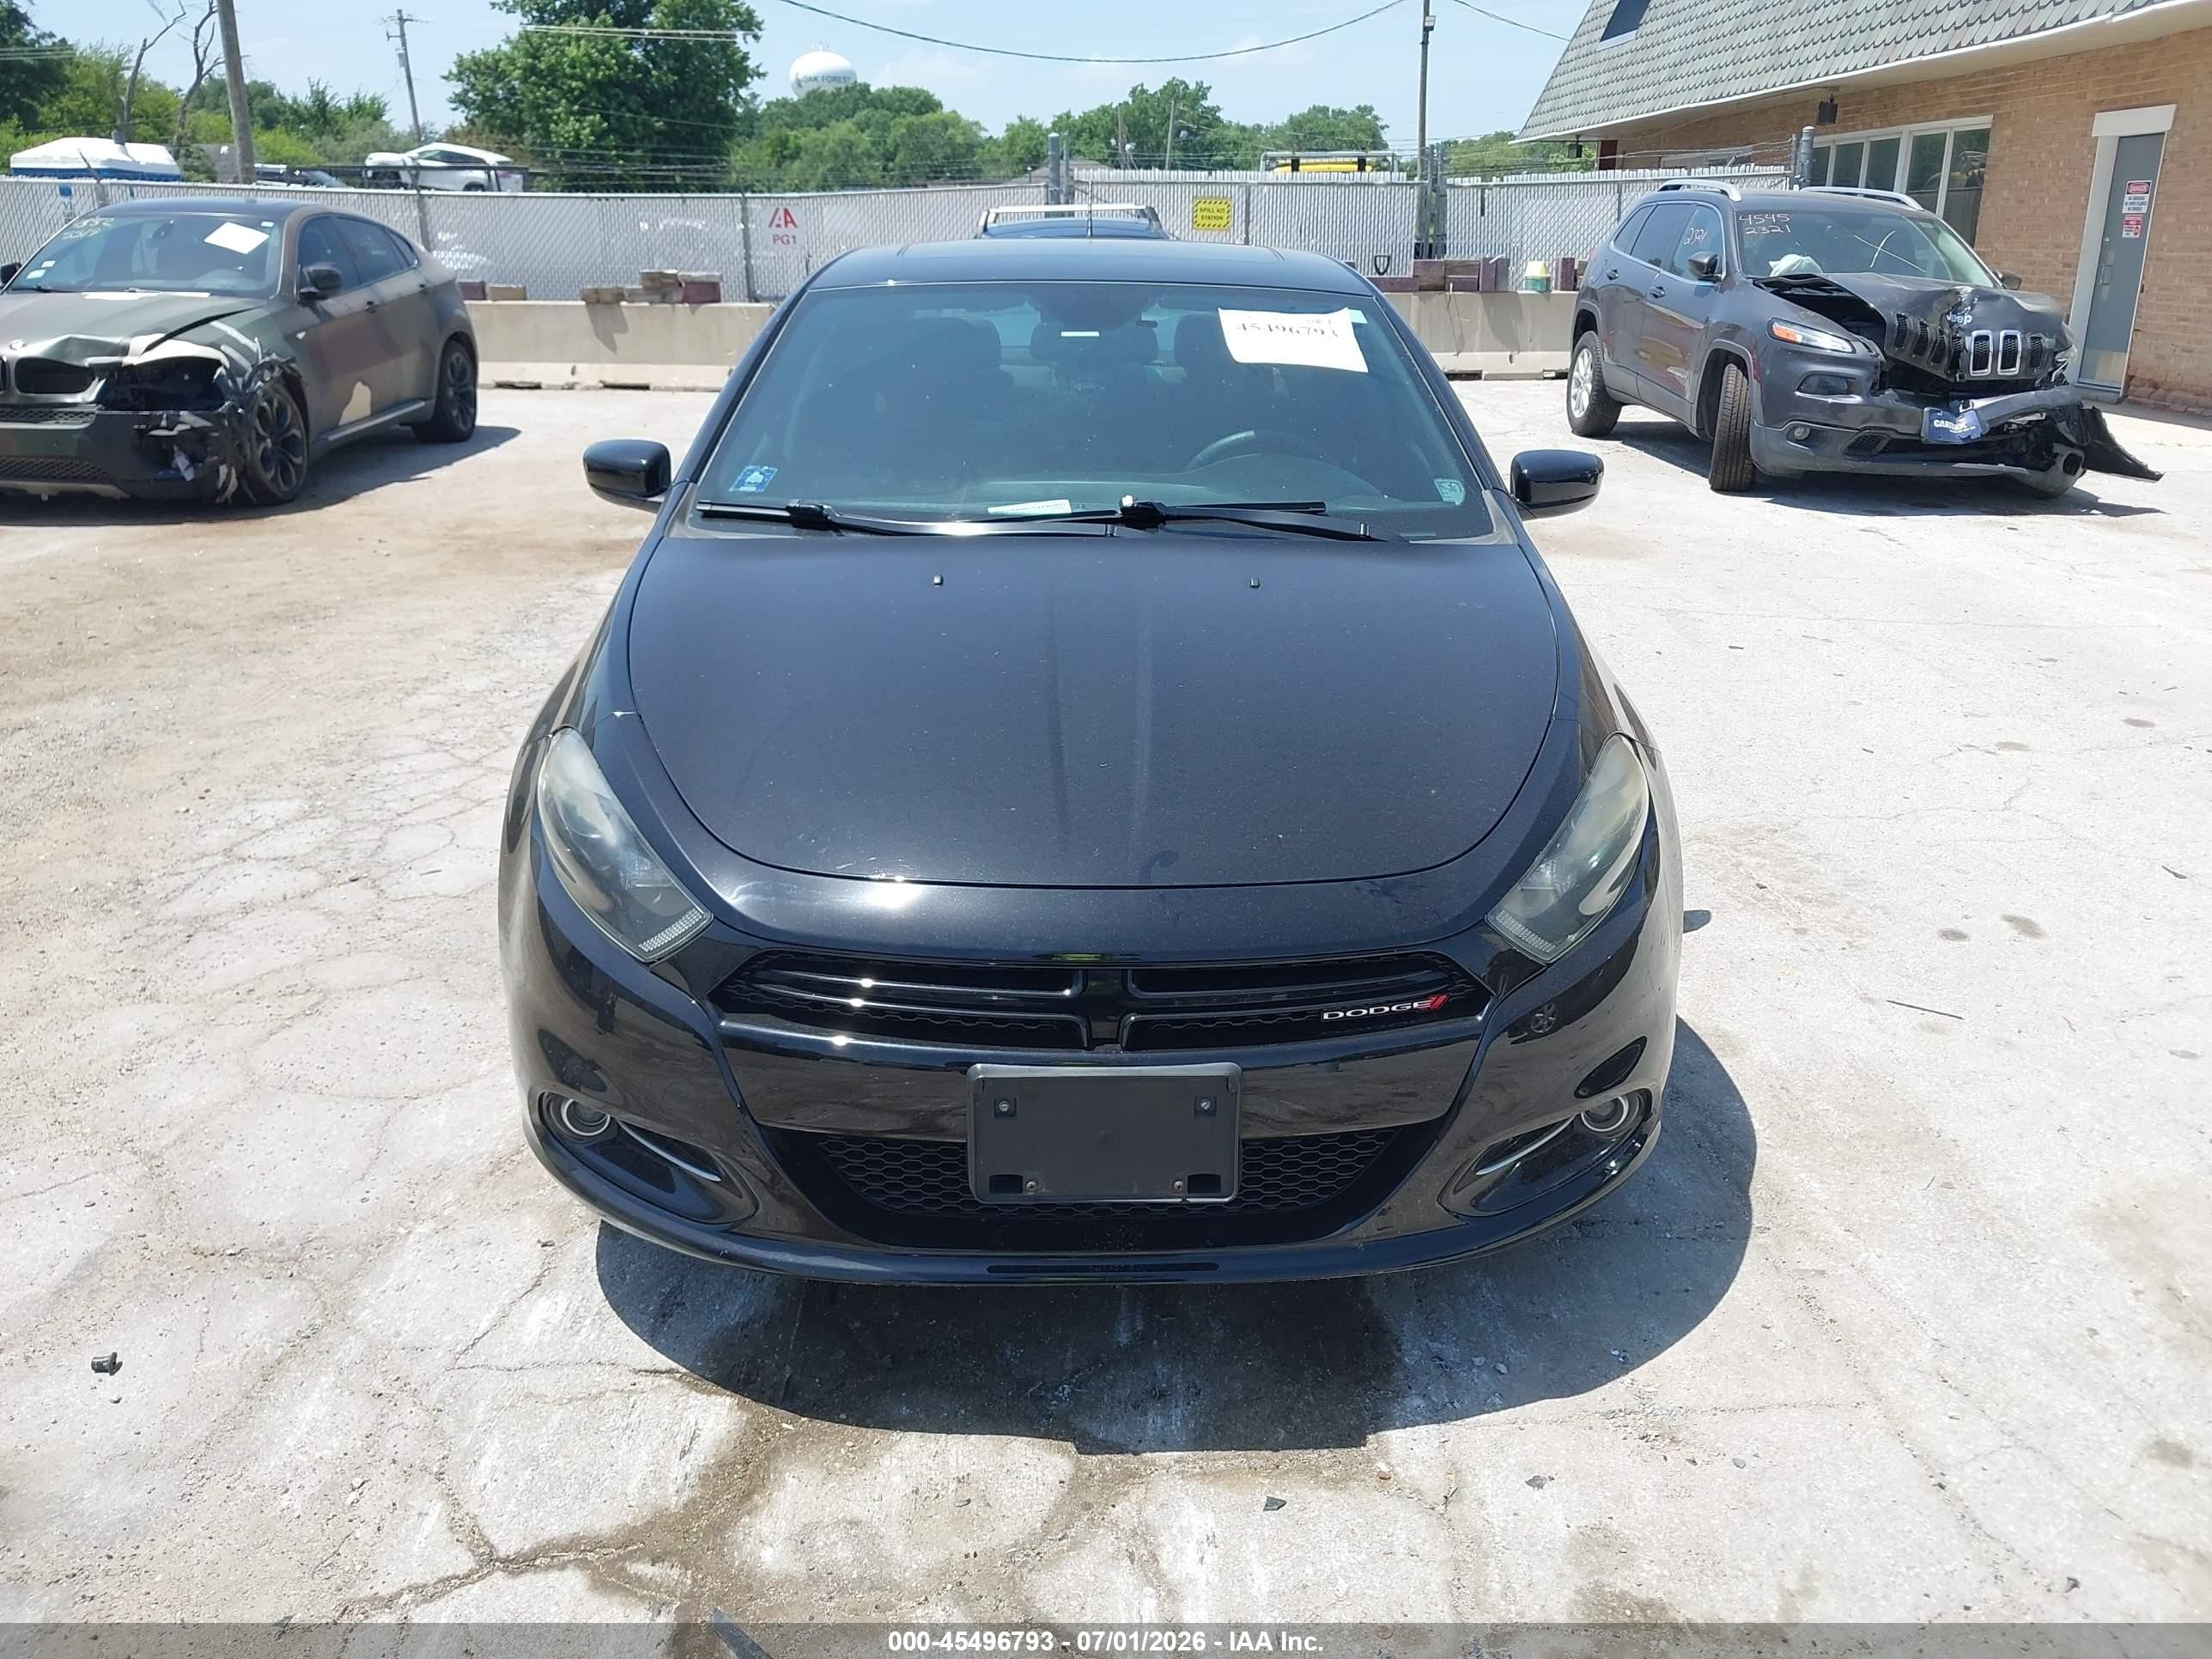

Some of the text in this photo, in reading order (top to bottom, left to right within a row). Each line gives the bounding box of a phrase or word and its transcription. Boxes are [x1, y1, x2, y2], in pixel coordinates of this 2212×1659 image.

[802, 75, 819, 83] OAK
[1739, 213, 1790, 225] 4545
[1745, 224, 1791, 234] 2321
[773, 234, 797, 246] PG1
[1946, 310, 1972, 325] Jeep
[1322, 1000, 1432, 1020] DODGE
